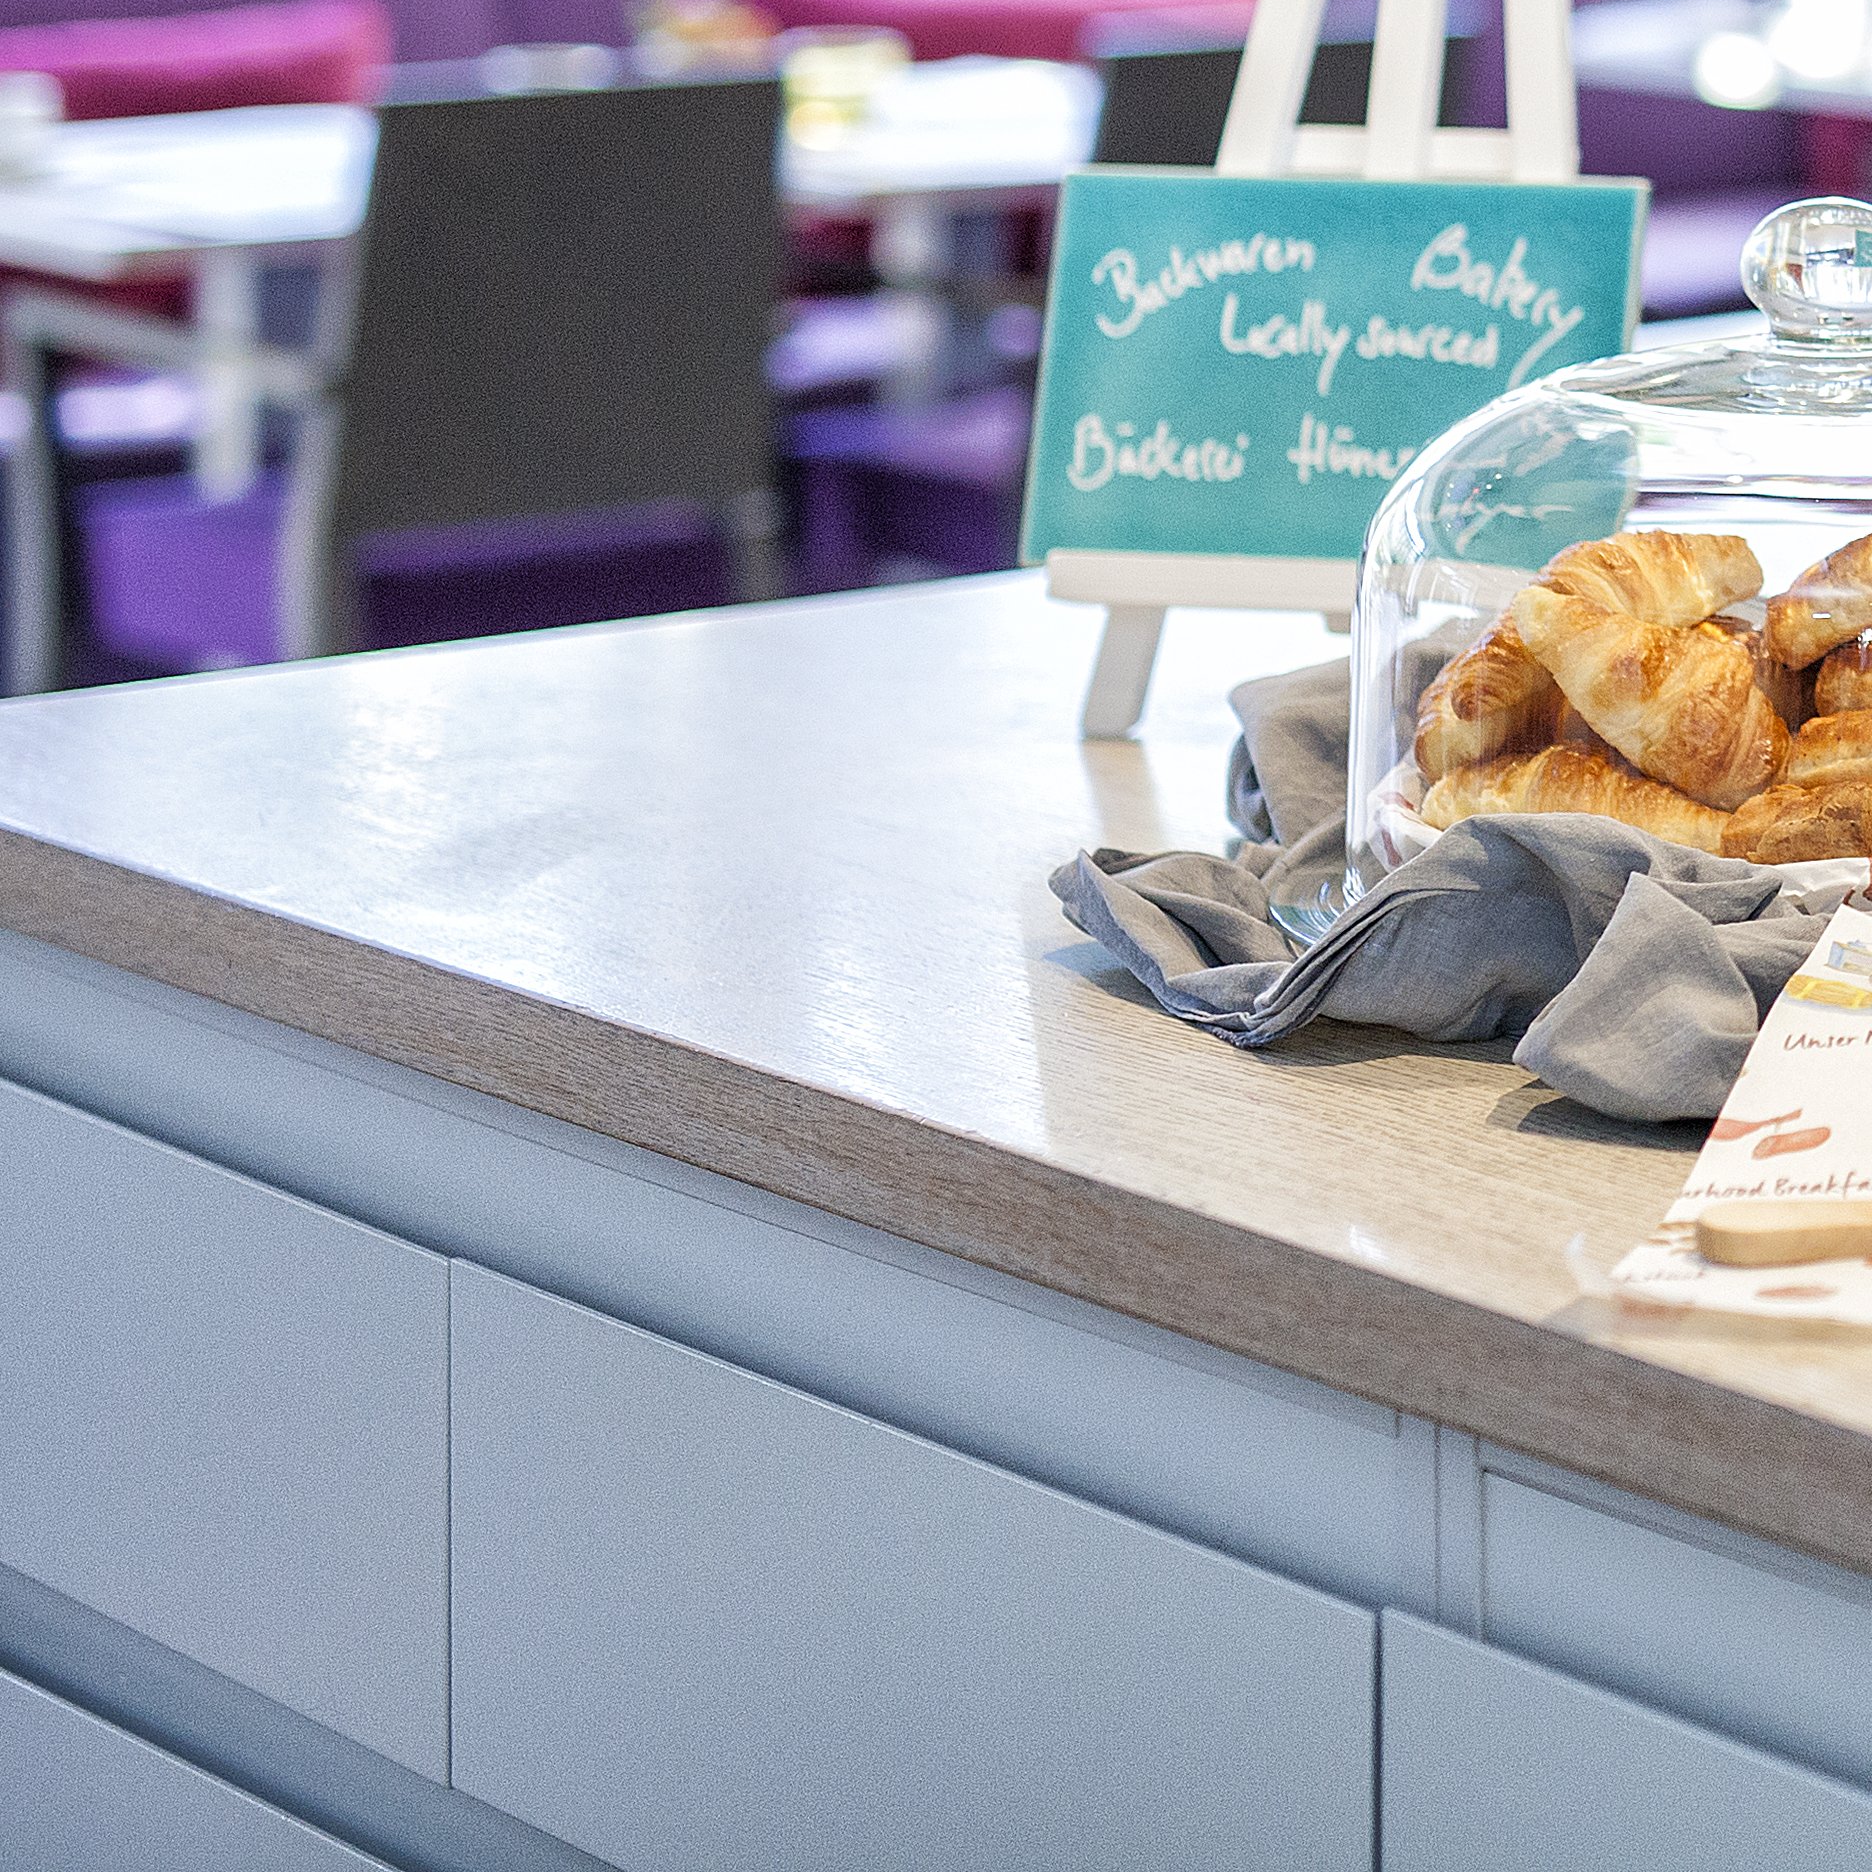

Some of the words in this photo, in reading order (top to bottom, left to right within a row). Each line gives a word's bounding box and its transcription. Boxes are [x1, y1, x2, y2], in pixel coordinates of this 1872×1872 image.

[1092, 231, 1316, 340] Backwaren
[1411, 223, 1584, 393] Bakery
[1066, 412, 1250, 493] Bäckerei
[1783, 1032, 1859, 1052] Unser
